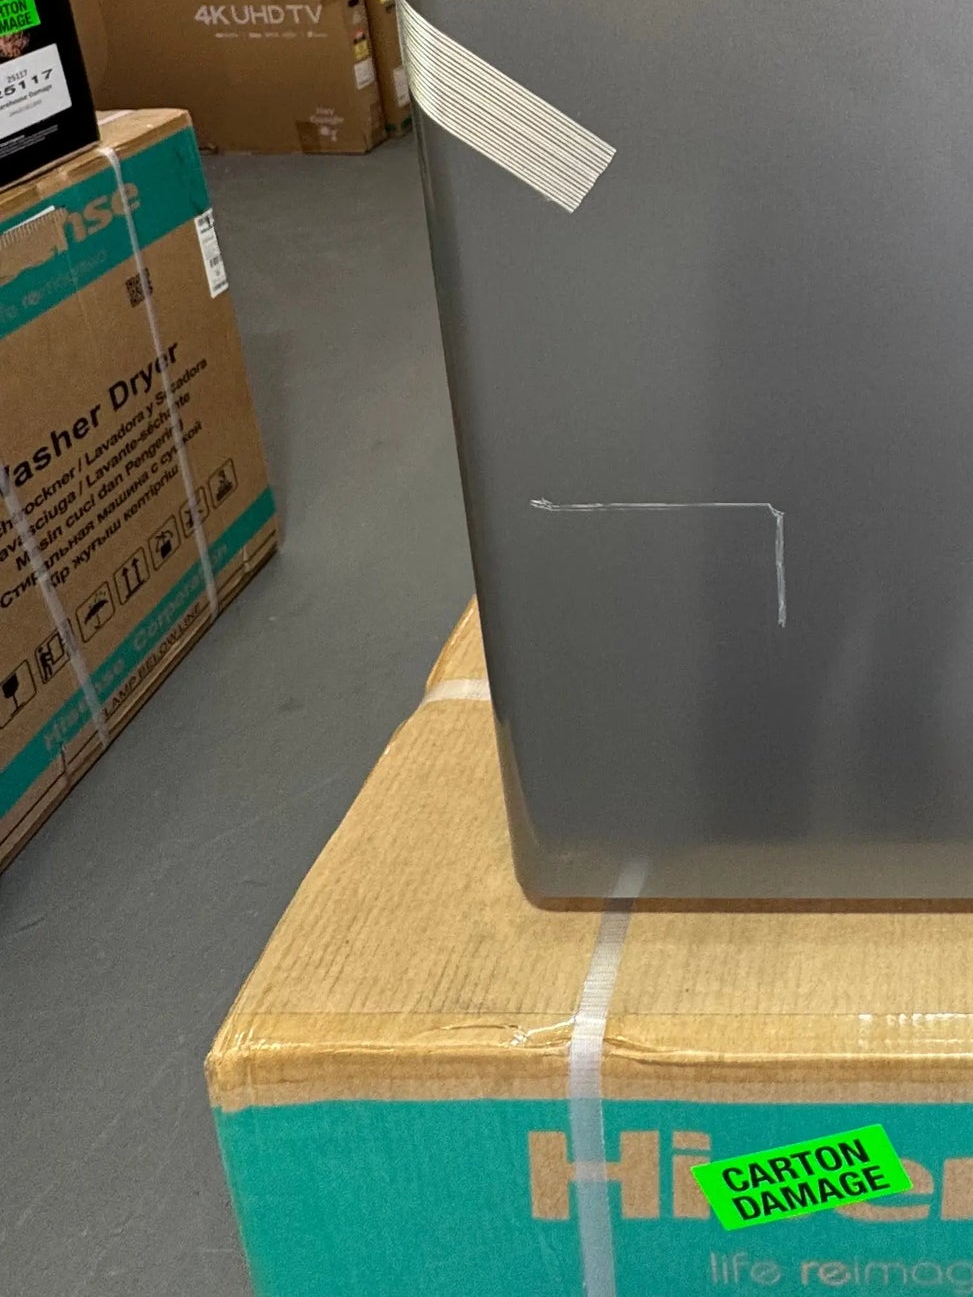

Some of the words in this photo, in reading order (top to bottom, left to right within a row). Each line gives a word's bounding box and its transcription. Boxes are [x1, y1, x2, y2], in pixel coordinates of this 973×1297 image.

[194, 5, 230, 25] 4K
[231, 5, 285, 25] UHD
[286, 4, 323, 24] TV
[0, 404, 101, 497] asher
[85, 411, 145, 467] Lavadora
[15, 526, 63, 571] Msin
[97, 473, 124, 501] dan
[125, 418, 184, 476] Pengeri
[103, 676, 138, 719] LAMP
[722, 1138, 870, 1193] CARTON
[732, 1165, 890, 1220] DAMAGE
[710, 1251, 782, 1286] life
